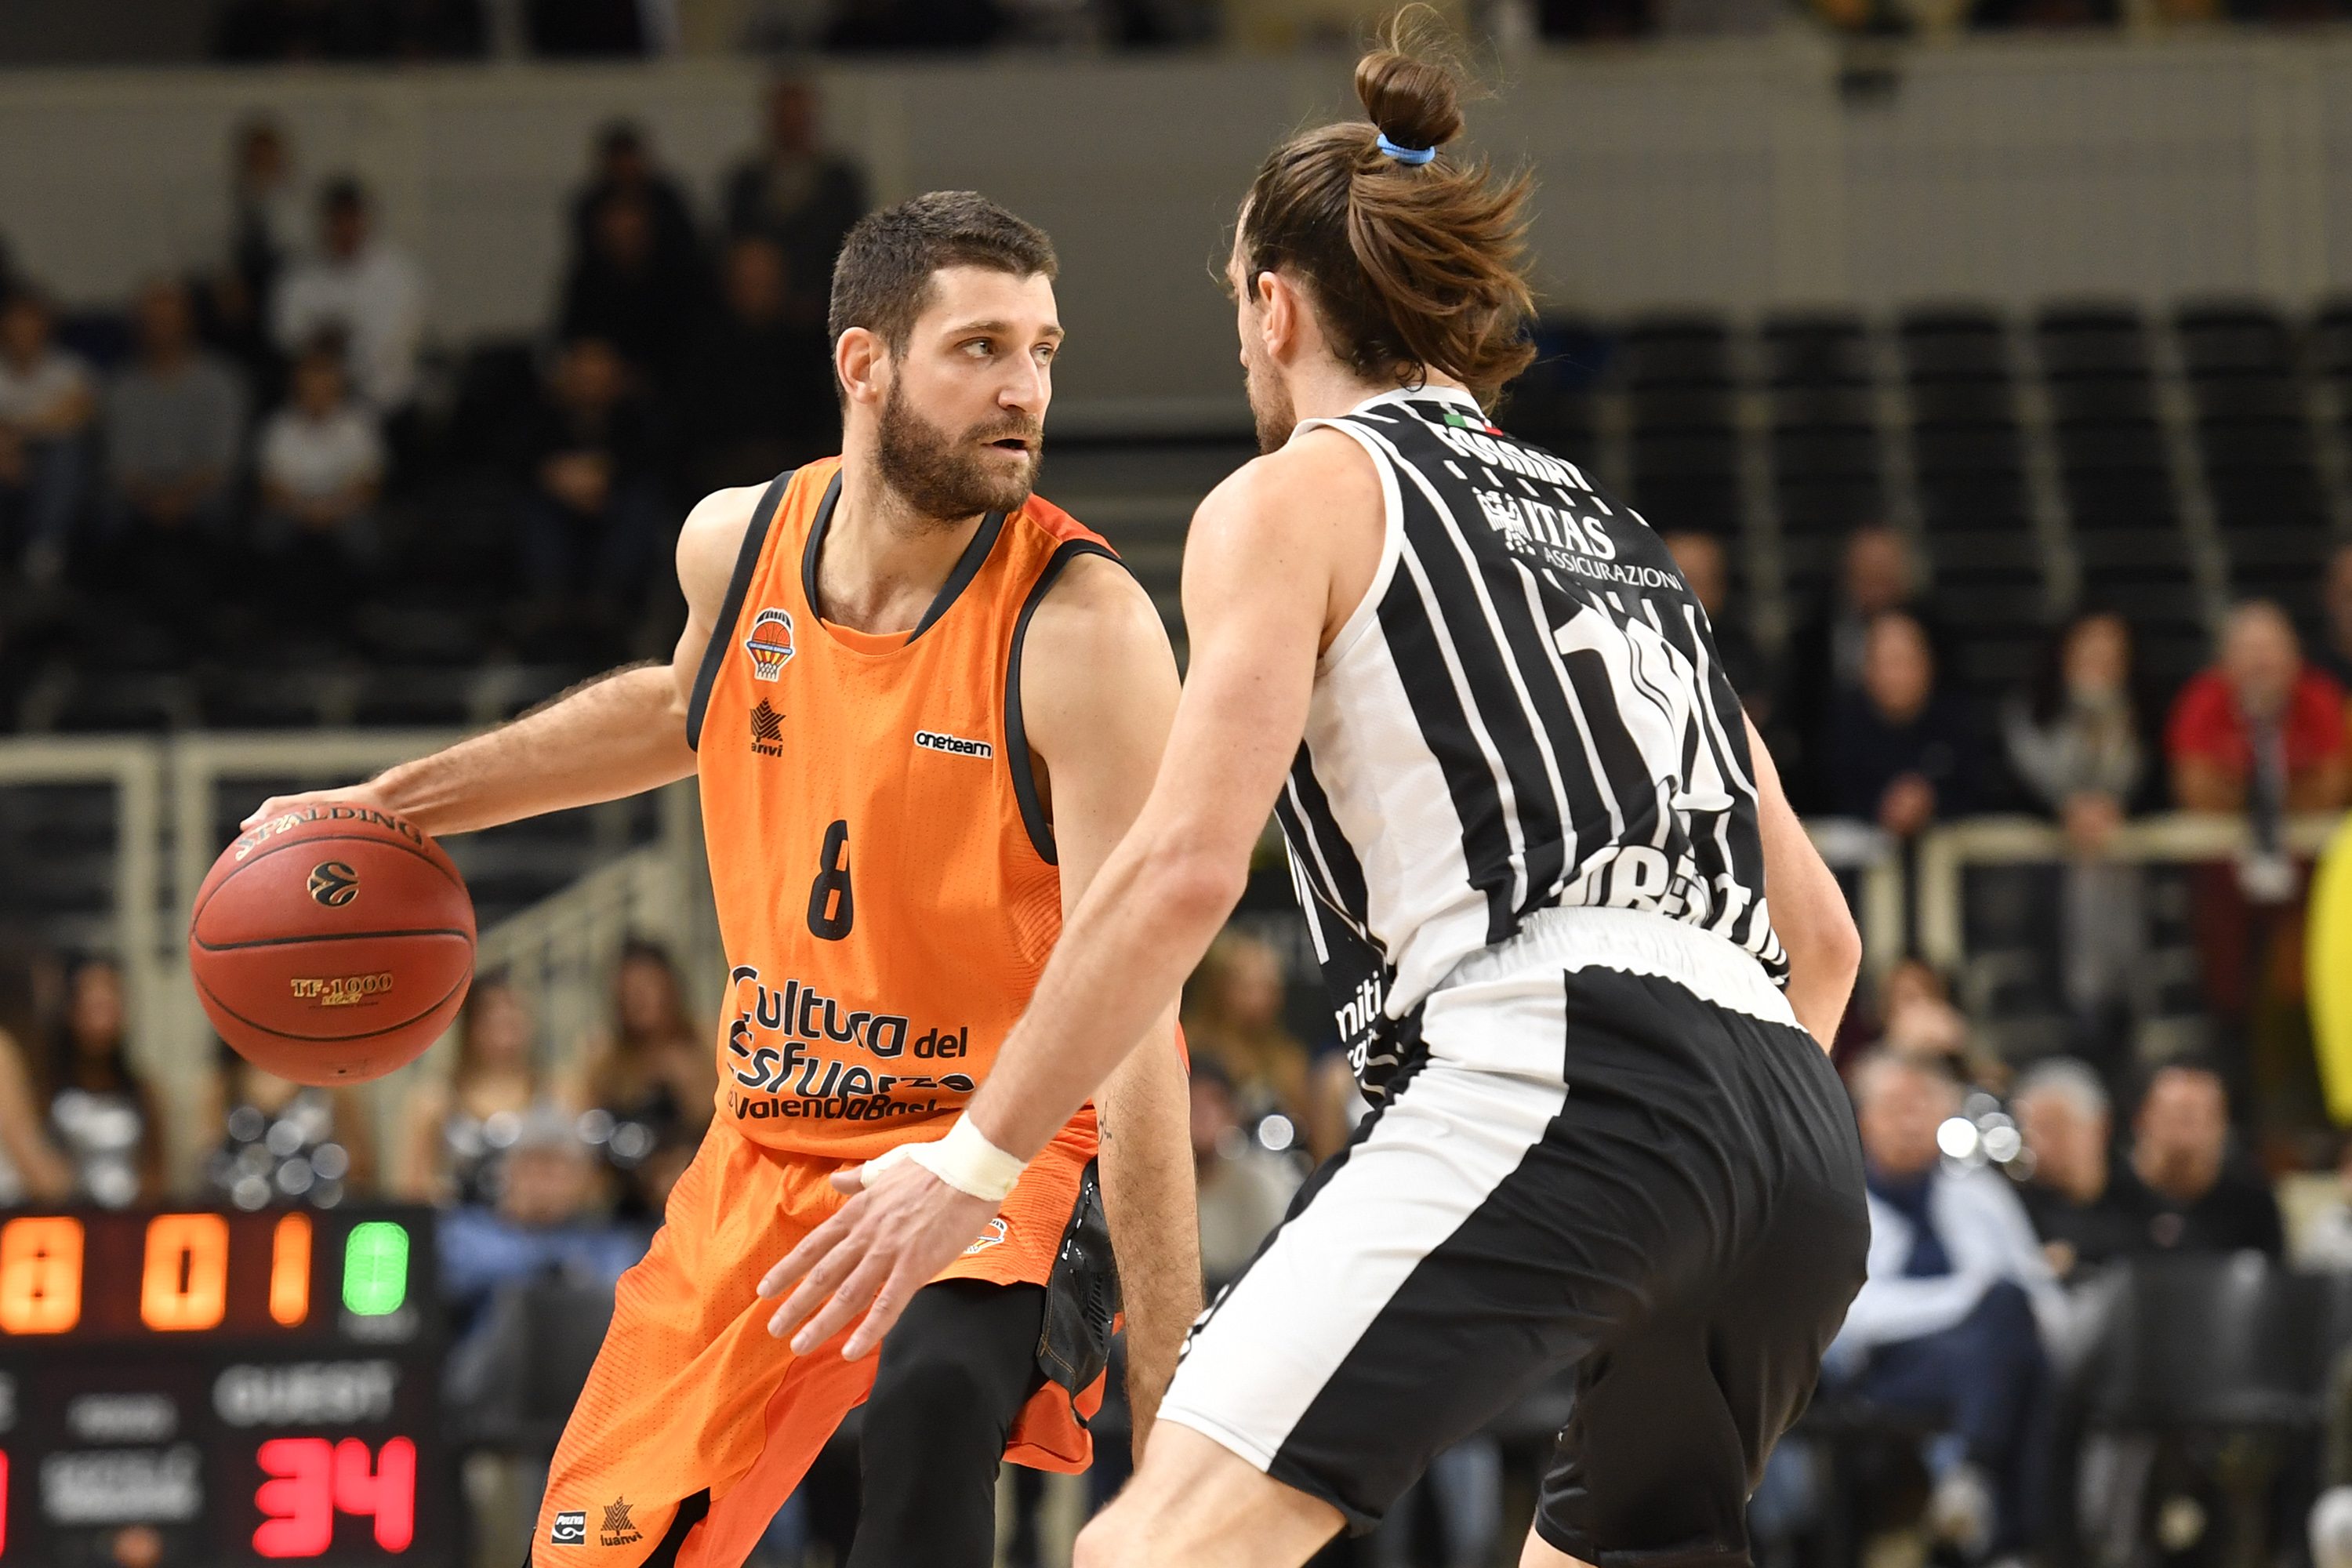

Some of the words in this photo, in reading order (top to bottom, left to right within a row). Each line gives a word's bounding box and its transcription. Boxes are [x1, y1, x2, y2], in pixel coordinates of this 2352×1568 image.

[1520, 498, 1616, 561] ITAS
[1543, 546, 1683, 592] ASSICURAZIONI
[916, 731, 991, 757] oneteam
[236, 807, 423, 861] SPALDING
[807, 819, 853, 941] 8
[291, 973, 393, 997] TF-1000
[732, 965, 909, 1058] Cultura
[914, 1026, 968, 1058] del
[252, 1436, 416, 1558] 34
[600, 1531, 644, 1547] luanvi
